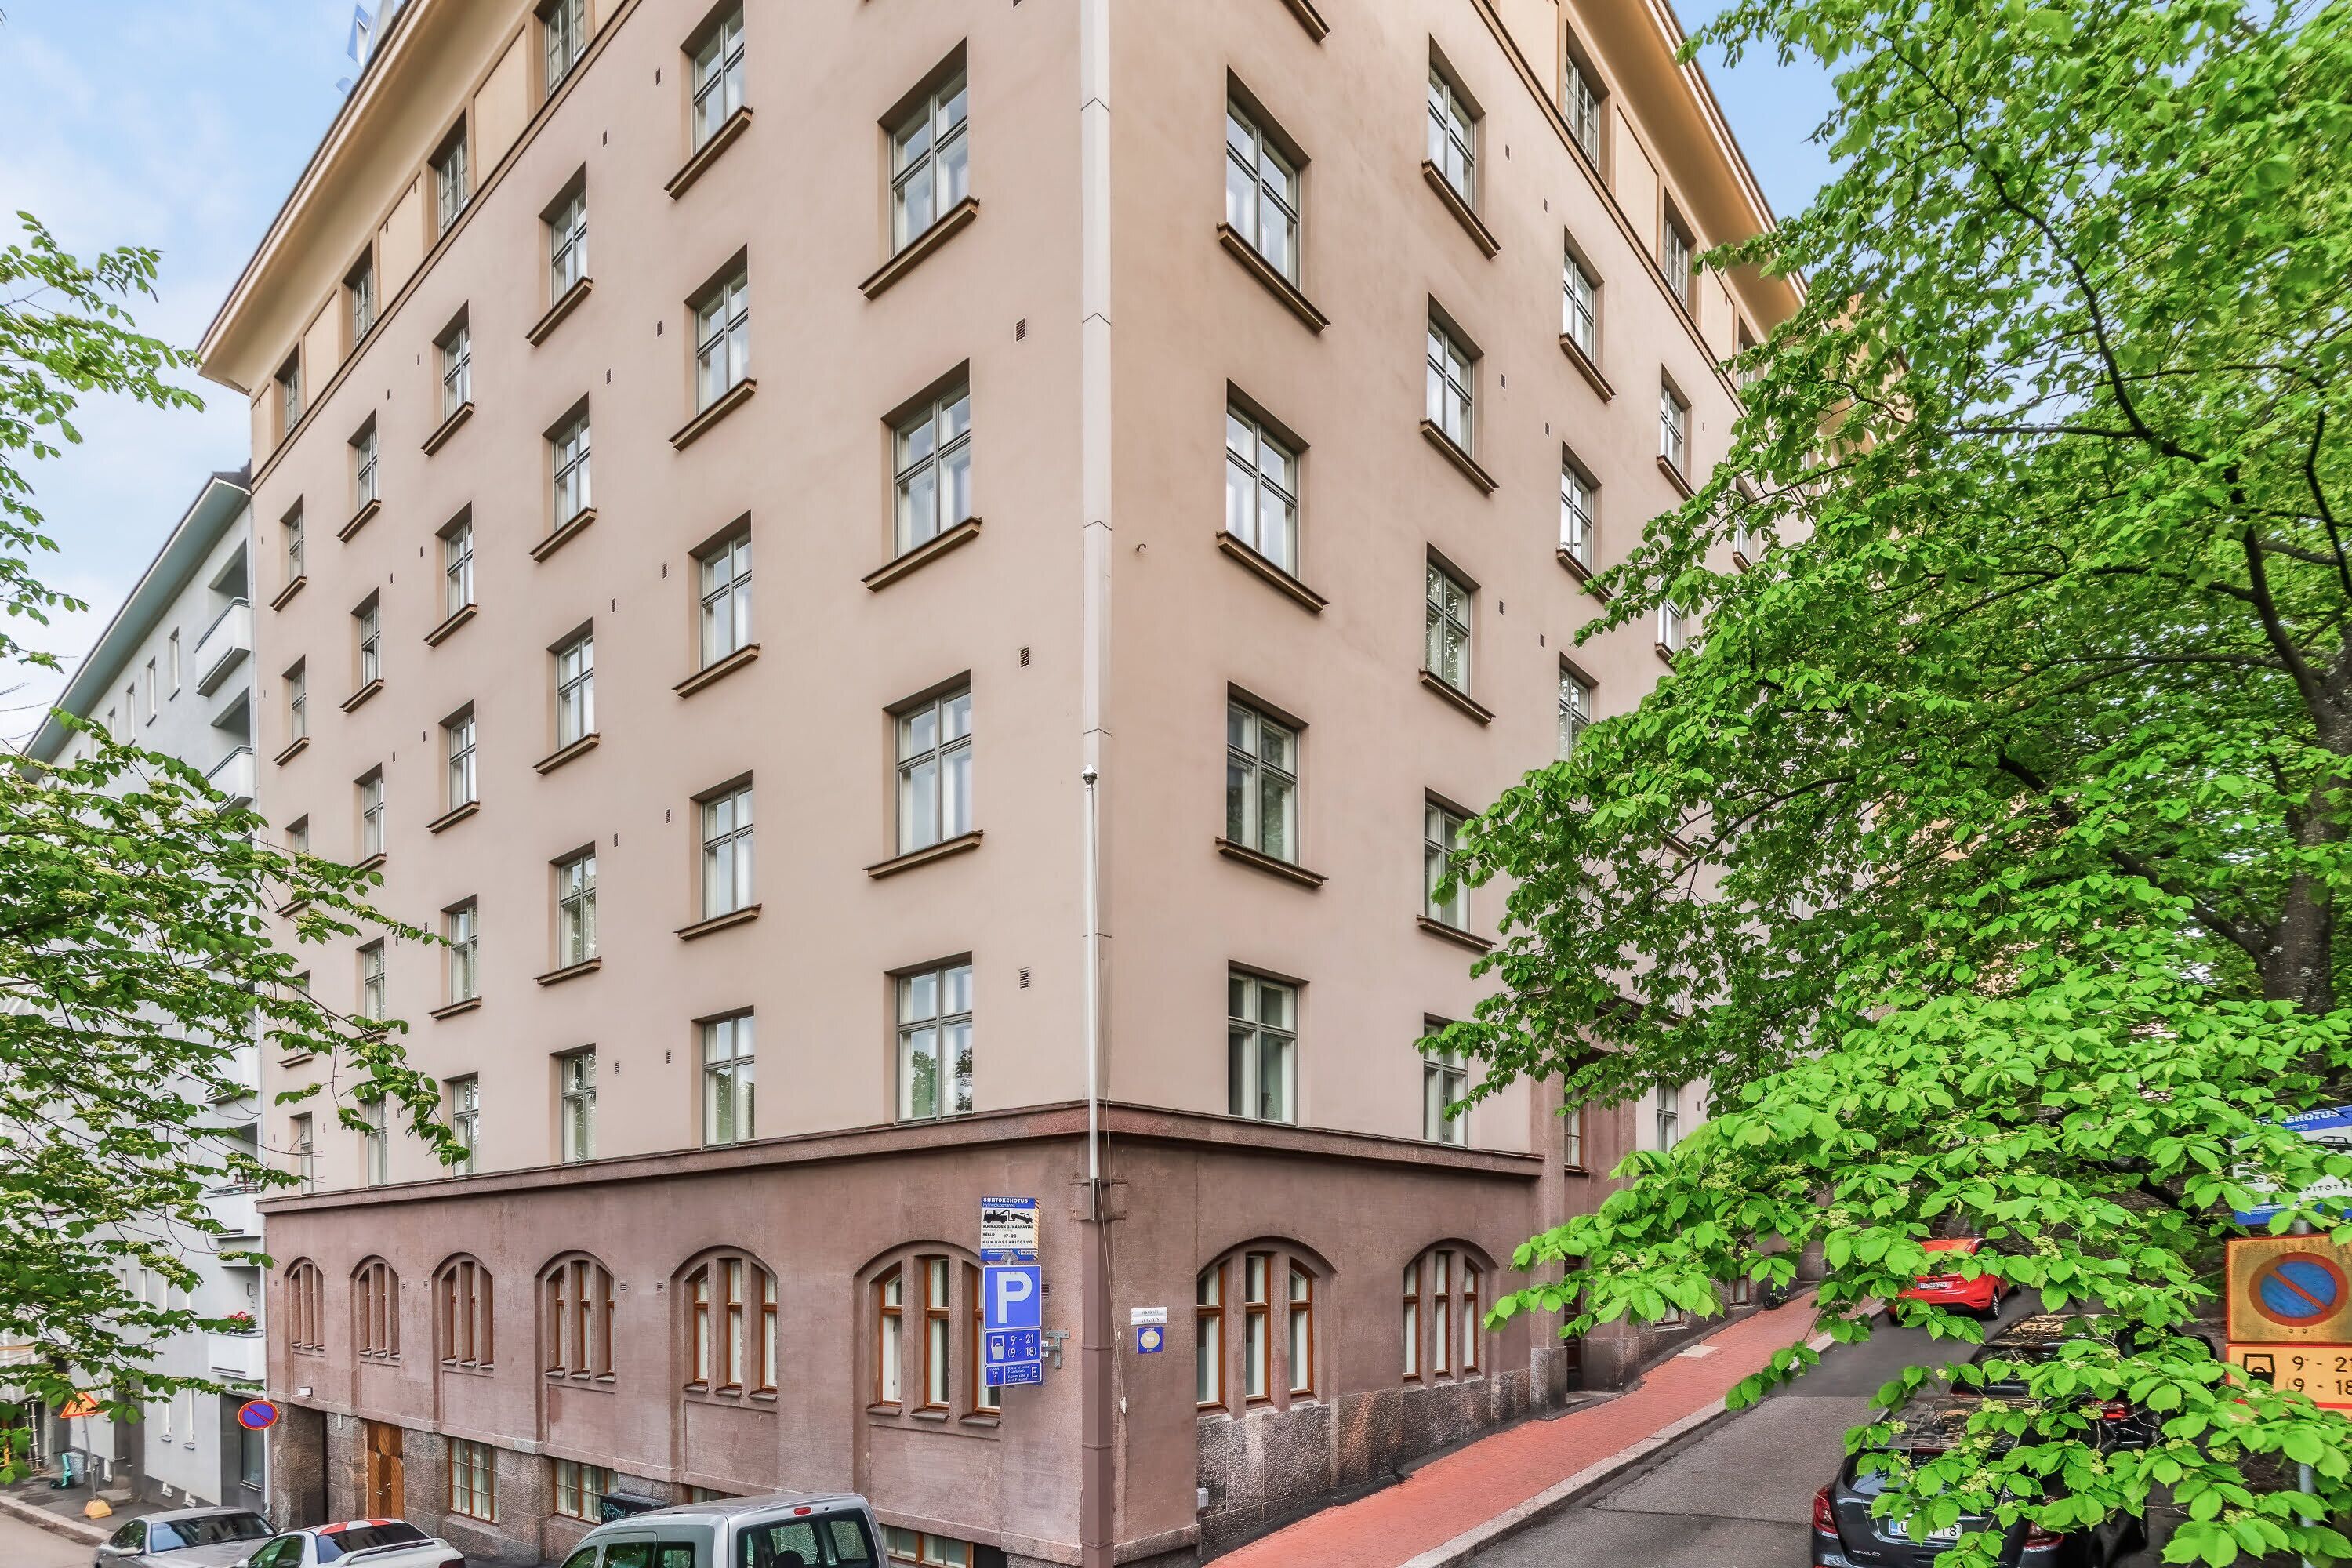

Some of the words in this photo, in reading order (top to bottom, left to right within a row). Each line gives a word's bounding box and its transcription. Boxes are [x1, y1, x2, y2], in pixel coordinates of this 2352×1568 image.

[997, 1272, 1033, 1323] P
[1011, 1335, 1016, 1345] 9
[1025, 1334, 1034, 1344] 21
[1007, 1348, 1016, 1358] (9
[1025, 1347, 1036, 1356] 18)
[2292, 1356, 2304, 1371] 9
[1031, 1366, 1038, 1378] E
